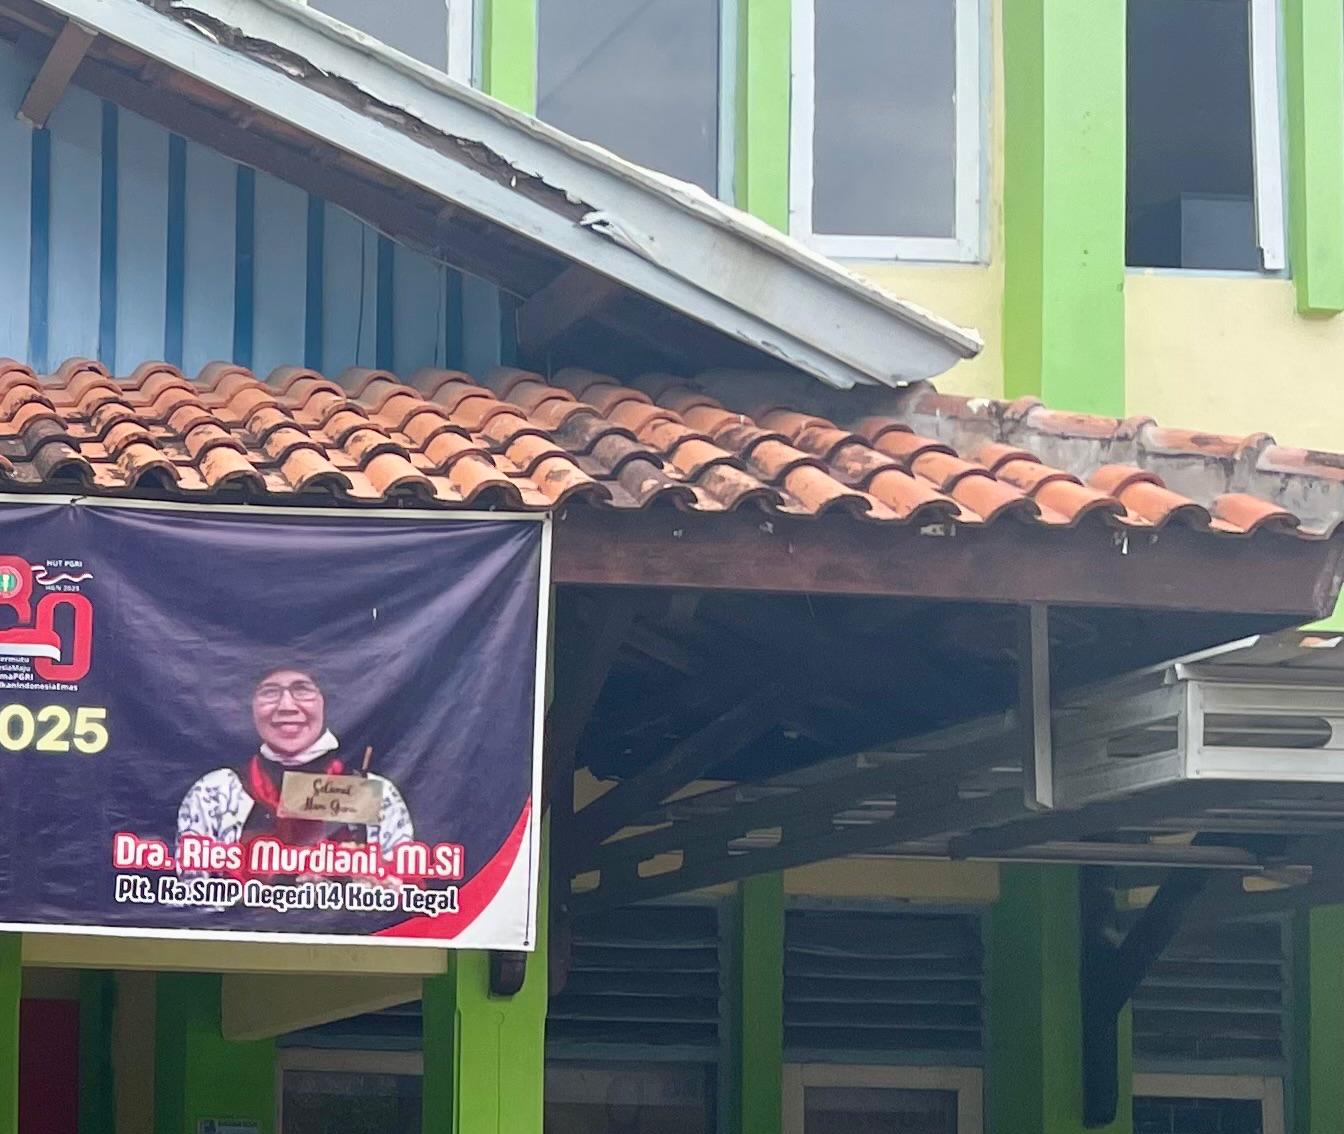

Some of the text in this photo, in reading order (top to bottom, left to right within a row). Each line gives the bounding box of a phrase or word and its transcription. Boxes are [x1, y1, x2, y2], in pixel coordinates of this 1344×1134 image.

[115, 836, 461, 877] Dra. Ries Murdiani, M.Si
[118, 876, 457, 915] Plt. Ka.SMP Negeri 14 Kota Tegal
